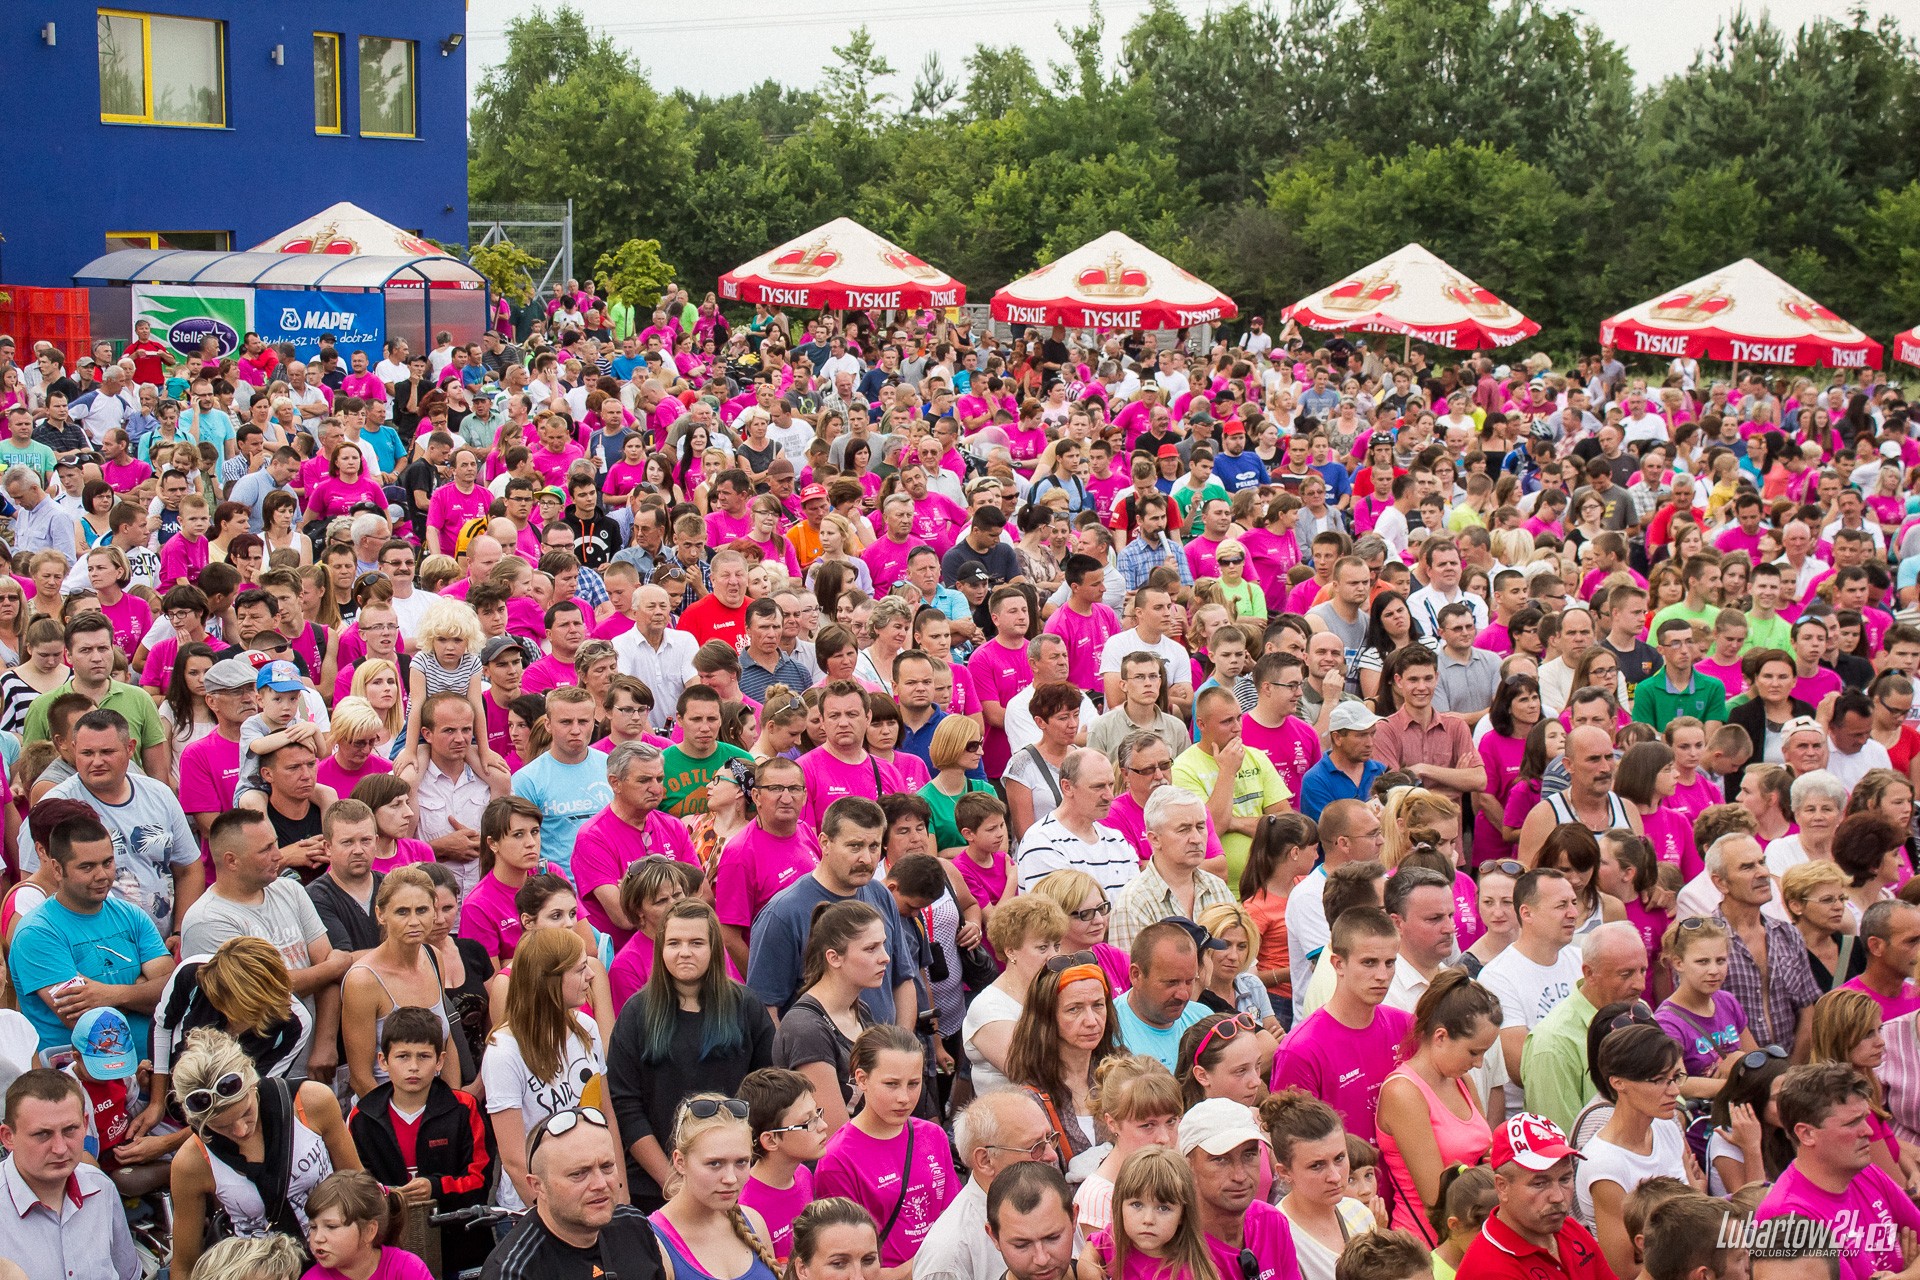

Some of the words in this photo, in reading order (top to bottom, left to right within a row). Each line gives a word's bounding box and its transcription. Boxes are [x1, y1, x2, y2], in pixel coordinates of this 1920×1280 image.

[758, 284, 809, 307] TYSKIE
[846, 290, 902, 309] TYSKIE
[930, 288, 957, 307] TYSKIE
[304, 311, 355, 331] MAPEI
[1006, 303, 1047, 324] TYSKIE
[1081, 309, 1142, 328] TYSKIE
[340, 328, 378, 345] dobrze!
[1634, 330, 1690, 355] TYSKIE
[1730, 339, 1797, 364] TYSKIE
[1831, 346, 1868, 367] TYSKIE
[663, 768, 718, 798] ORTL
[1711, 1023, 1740, 1046] THE
